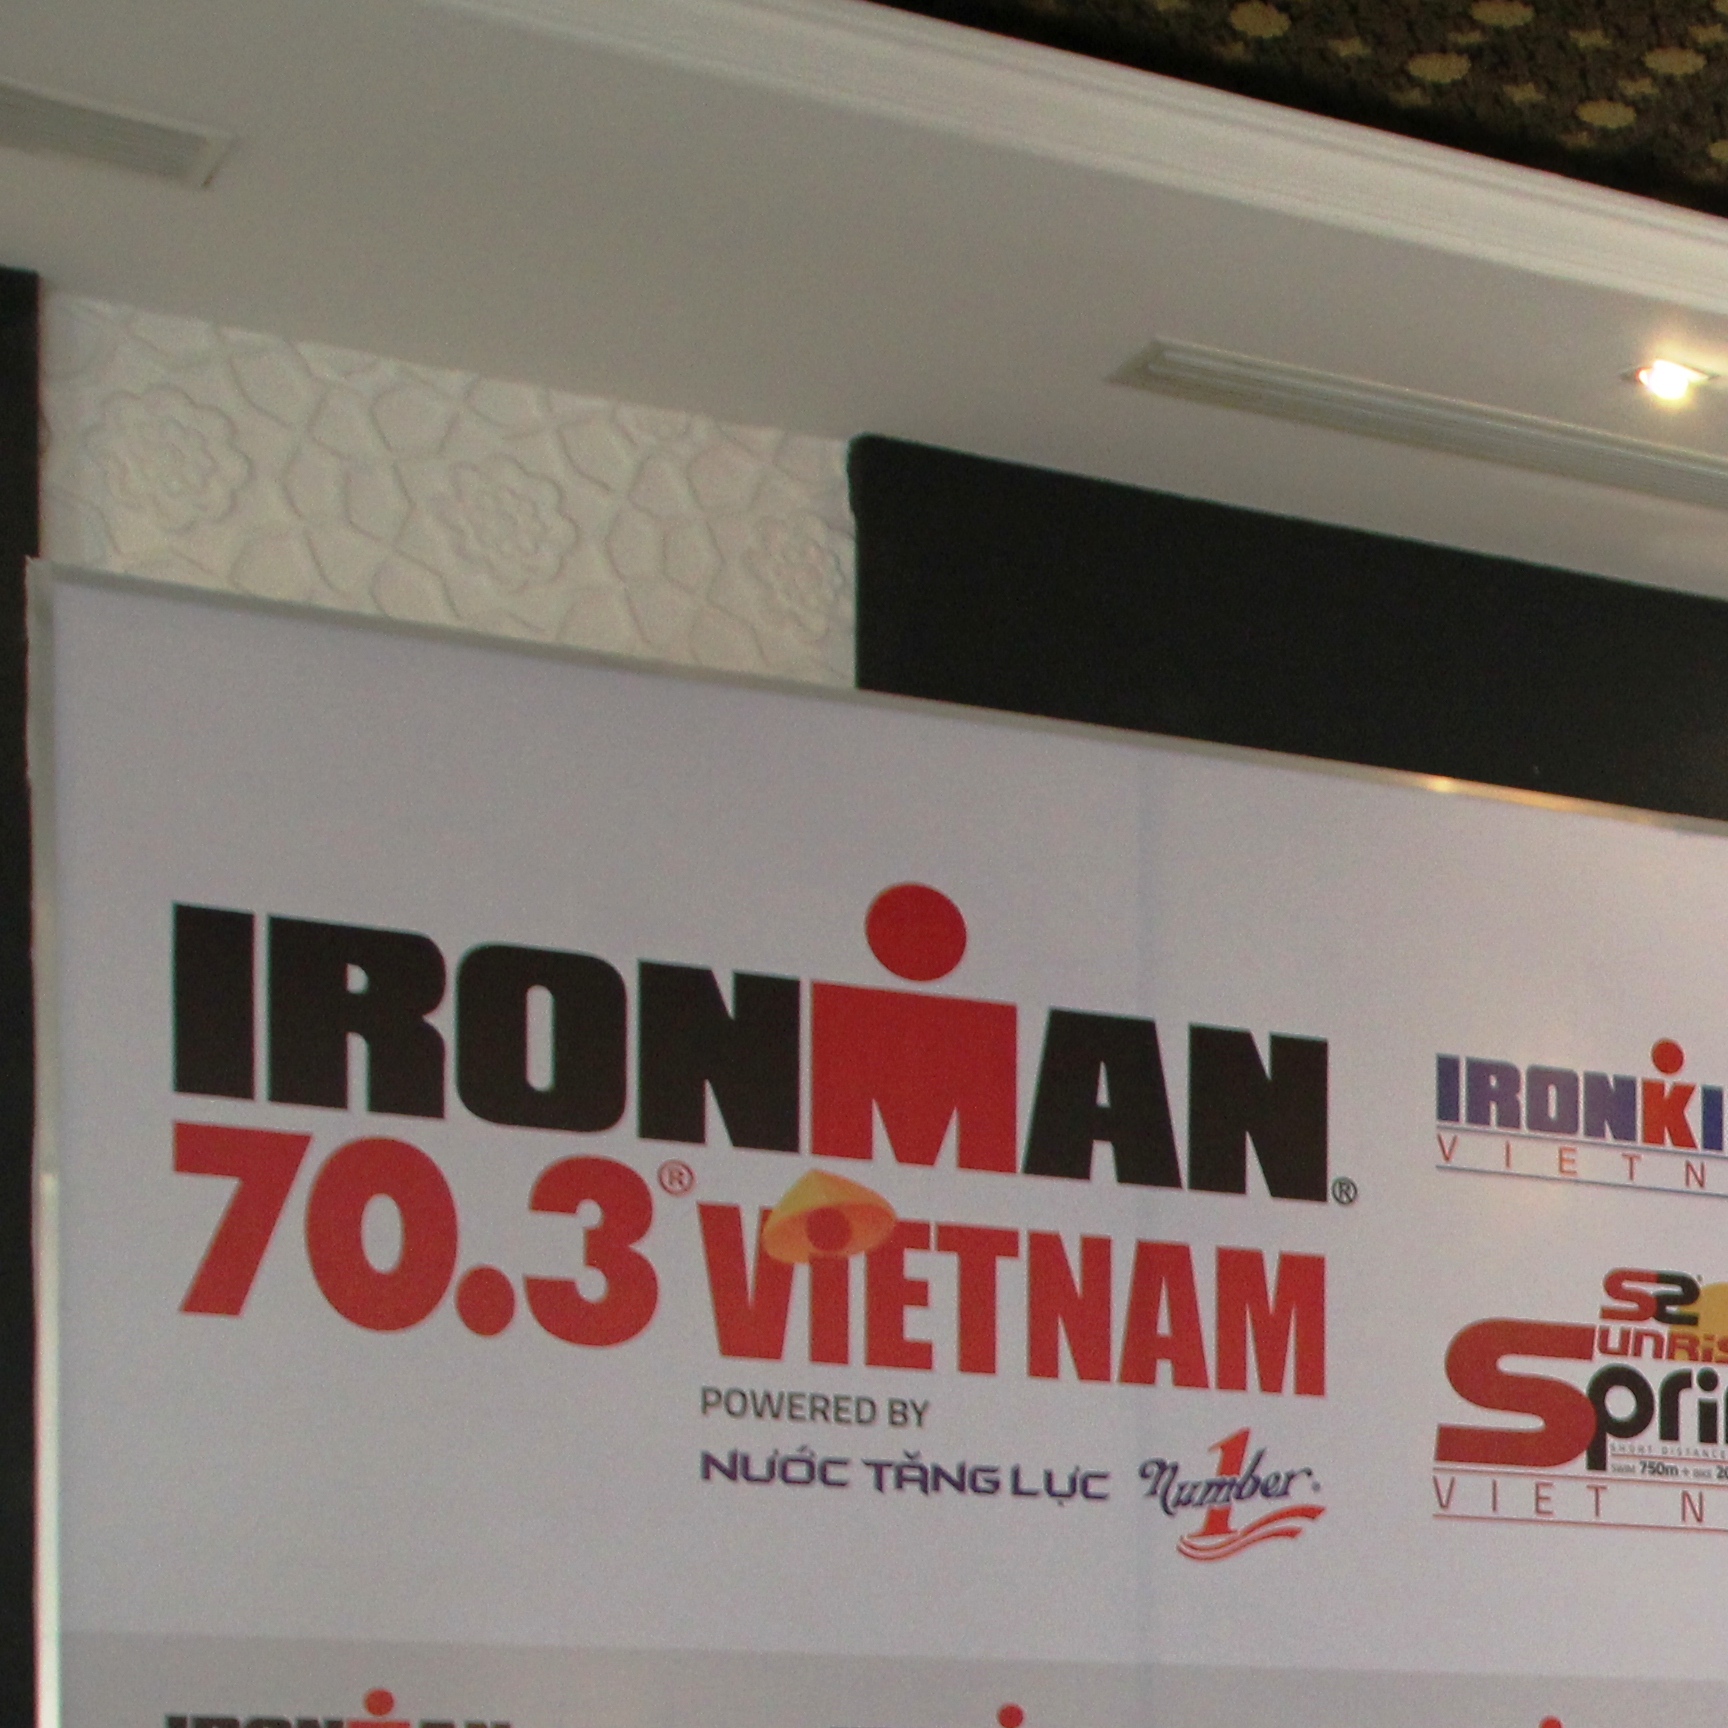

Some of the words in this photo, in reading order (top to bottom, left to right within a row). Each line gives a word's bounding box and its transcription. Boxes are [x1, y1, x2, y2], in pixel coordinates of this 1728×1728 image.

[171, 901, 1328, 1203] IRONMAN
[171, 1119, 660, 1348] 70.3
[697, 1200, 1327, 1399] VIETNAM
[701, 1386, 876, 1425] POWERED
[888, 1399, 930, 1428] BY
[1640, 1460, 1679, 1477] 750m
